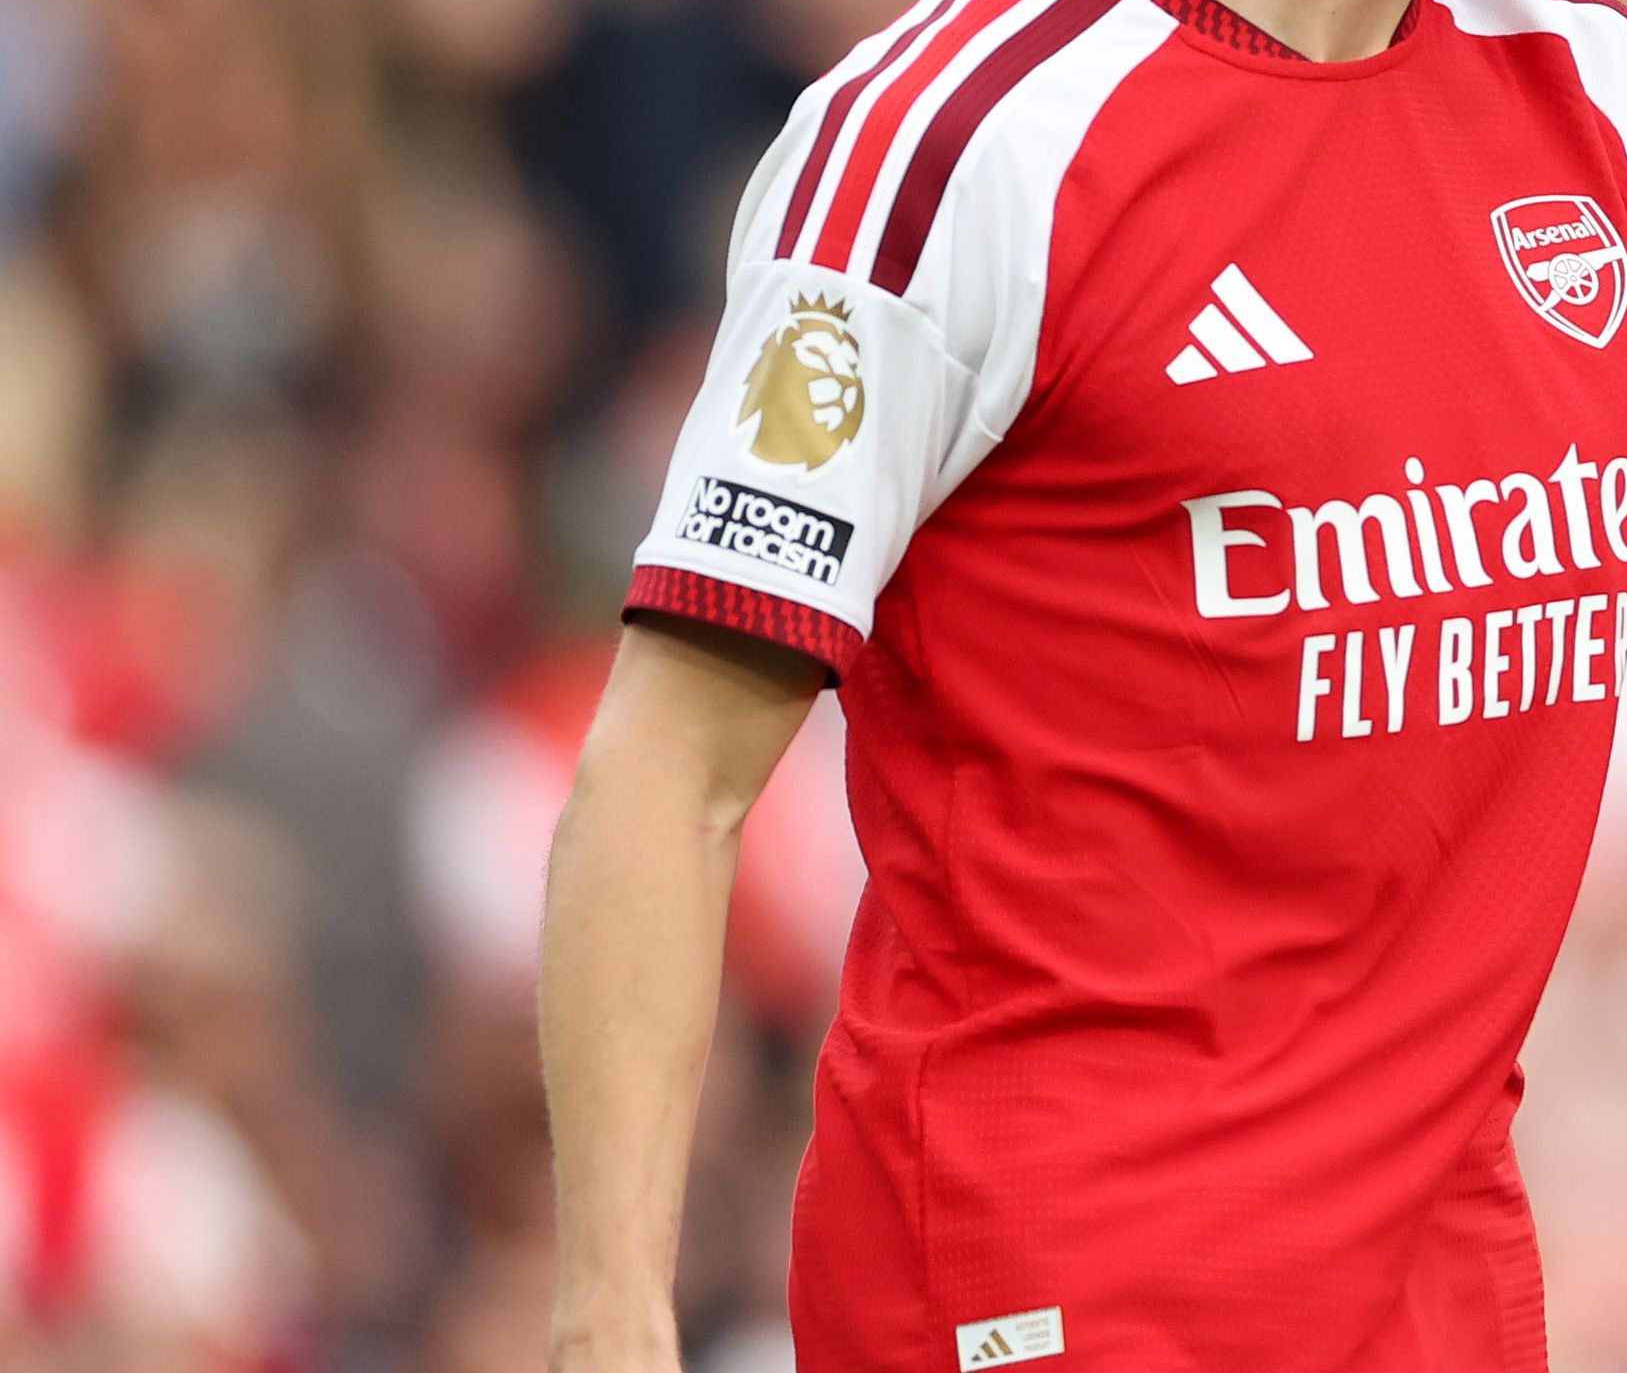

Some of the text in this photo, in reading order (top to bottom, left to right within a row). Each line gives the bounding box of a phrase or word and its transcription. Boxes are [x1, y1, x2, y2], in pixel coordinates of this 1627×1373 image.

[1511, 215, 1600, 251] Arsenal
[690, 478, 835, 552] No room
[720, 519, 842, 586] racism
[1297, 623, 1416, 743] FLY
